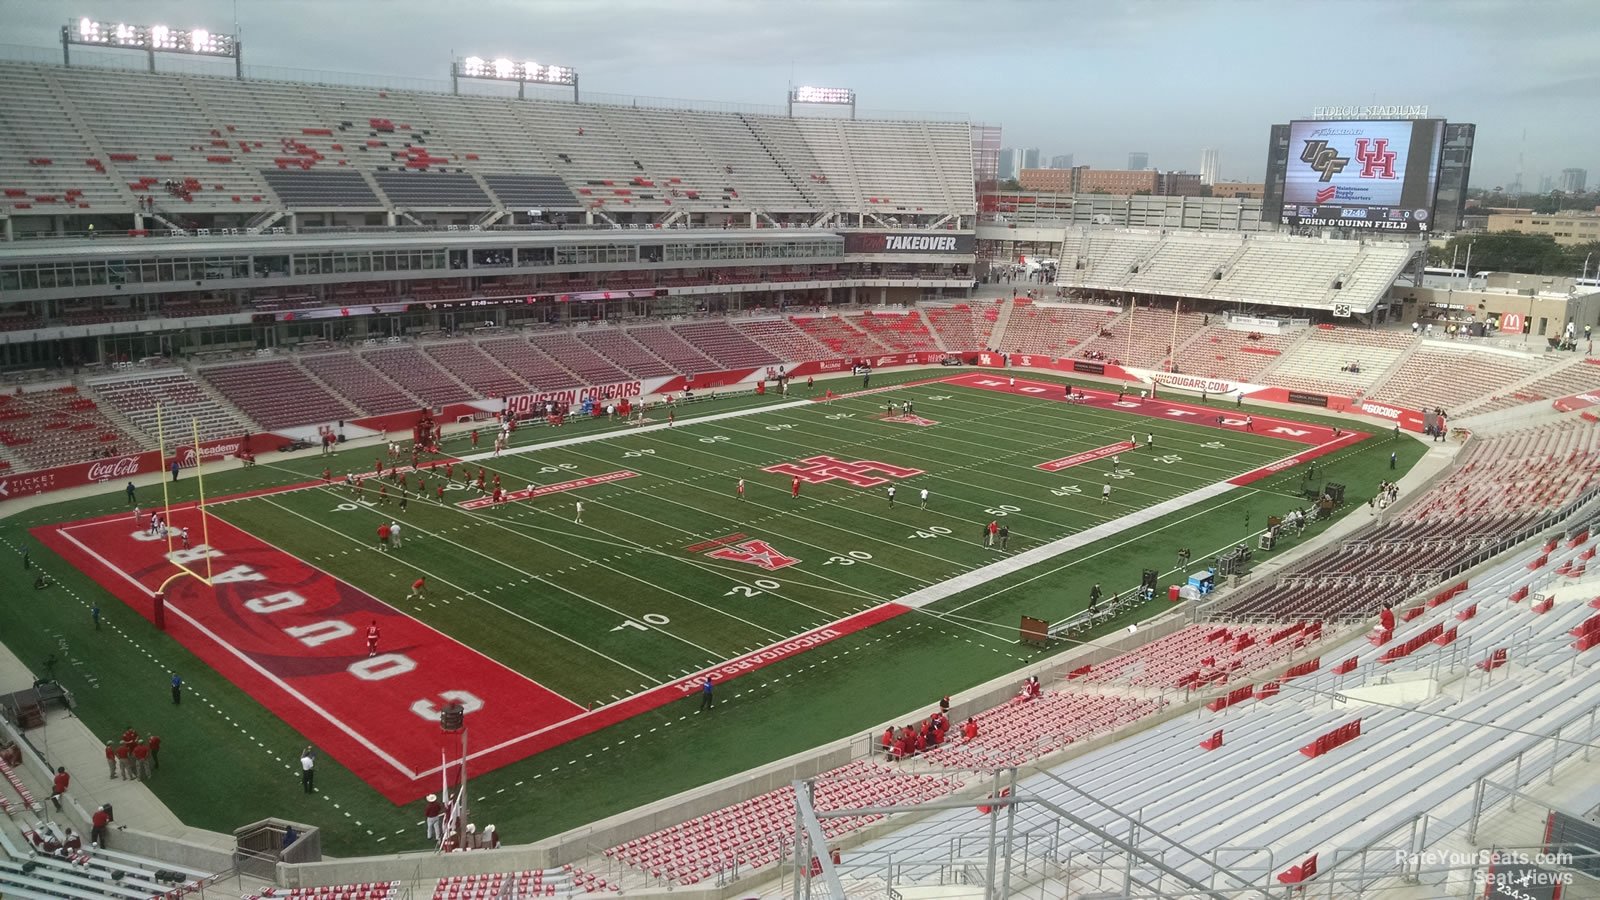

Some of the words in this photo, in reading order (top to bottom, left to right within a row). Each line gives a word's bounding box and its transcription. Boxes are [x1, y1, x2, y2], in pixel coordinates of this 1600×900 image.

[1366, 104, 1421, 116] STADIUM
[1301, 140, 1350, 182] UCF
[1355, 138, 1397, 179] UH
[1299, 217, 1327, 226] JOHN
[1328, 218, 1373, 228] O'QUINN
[1374, 221, 1408, 230] FIELD
[885, 236, 956, 251] TAKEOVER
[1335, 305, 1350, 316] 25
[580, 381, 642, 404] COUGARS
[199, 443, 240, 455] Academy
[88, 456, 141, 481] Coca-Cola
[12, 474, 55, 487] TICKET
[13, 482, 55, 493] GALAXY
[984, 504, 1022, 517] 50
[916, 526, 954, 540] 40
[829, 550, 874, 566] 30
[733, 579, 782, 598] 20
[622, 613, 671, 632] 10
[674, 629, 843, 693] UHCOUGARS.COM
